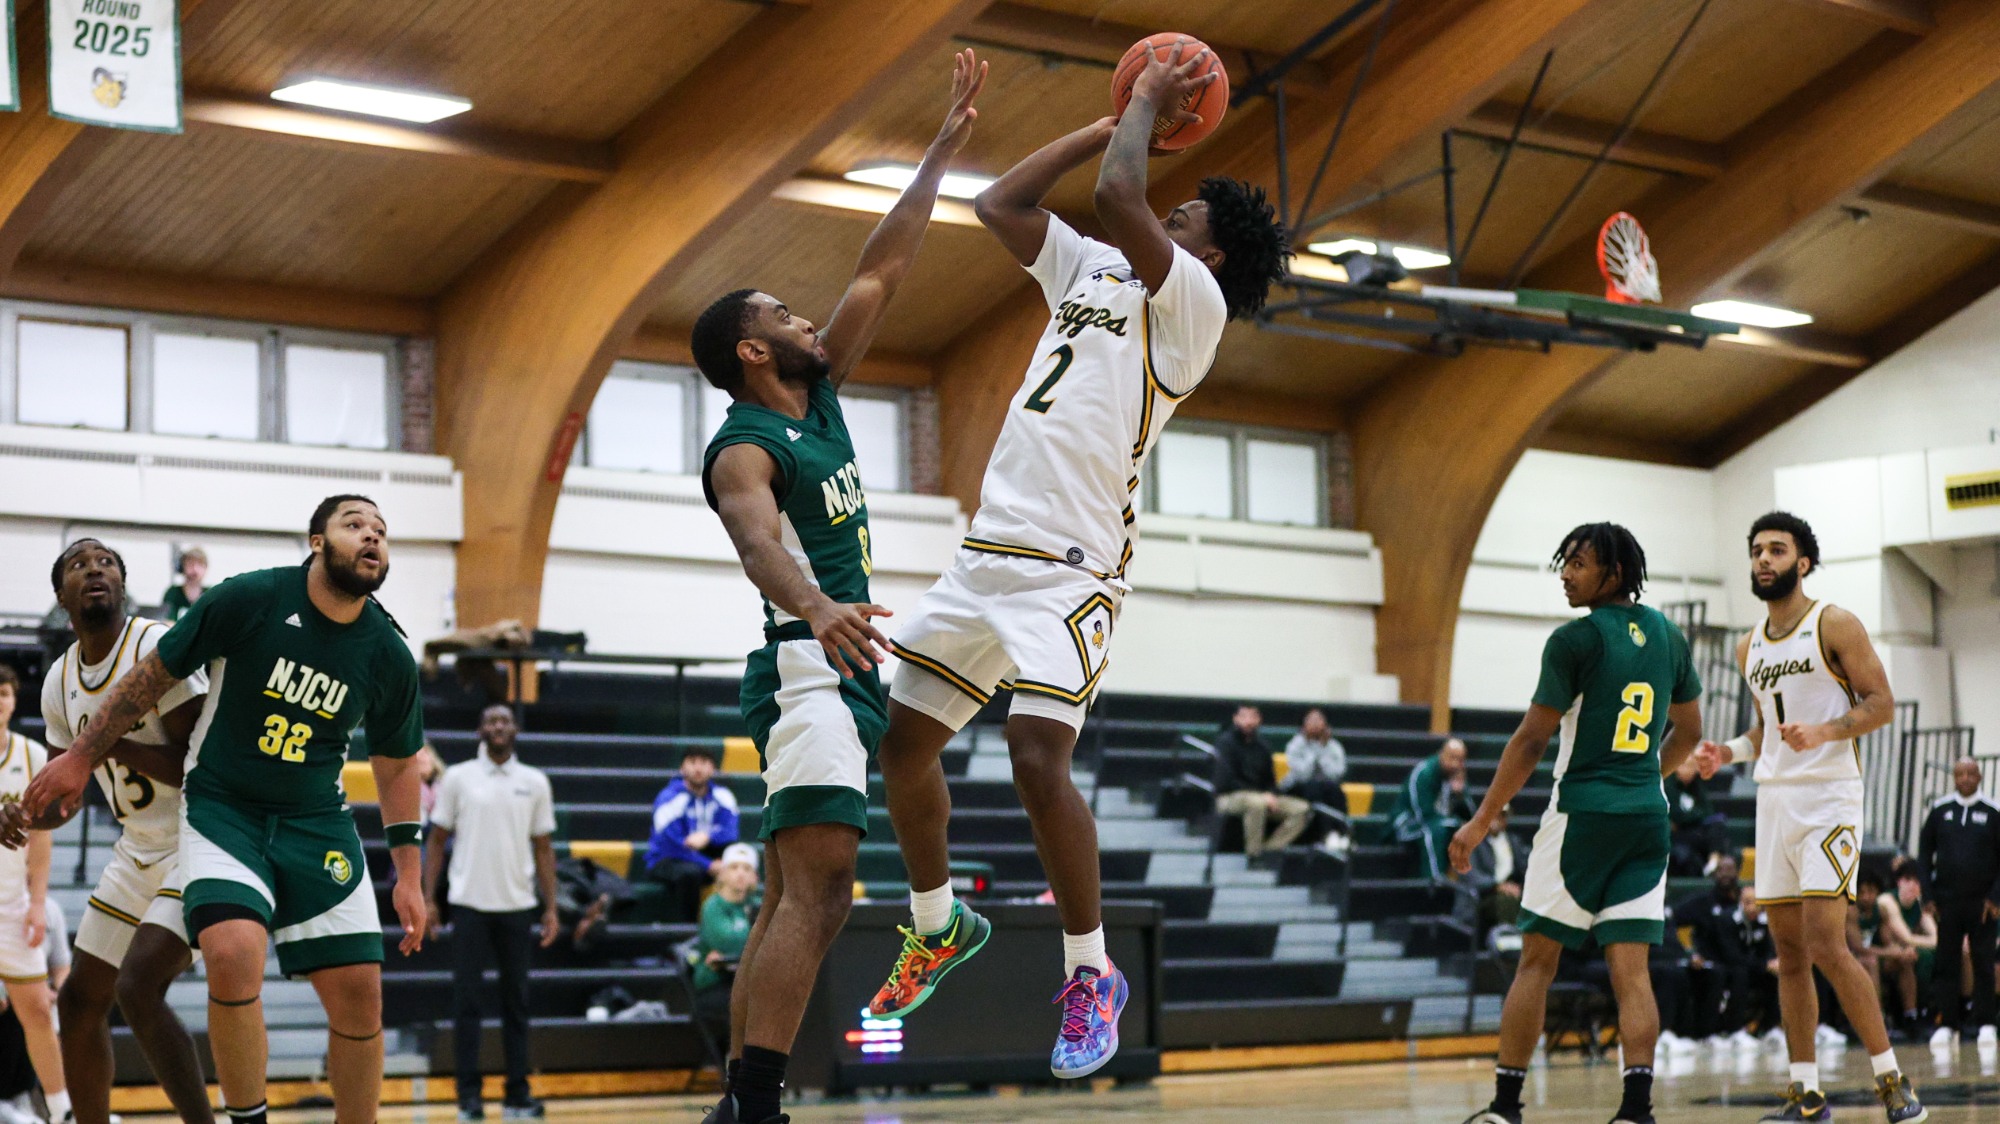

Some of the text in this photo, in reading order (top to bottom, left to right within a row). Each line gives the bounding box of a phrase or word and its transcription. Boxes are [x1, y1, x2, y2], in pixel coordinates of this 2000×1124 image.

[82, 0, 141, 20] ROUND
[73, 19, 152, 57] 2025
[1023, 343, 1073, 415] 2
[265, 656, 349, 714] NJCU
[1749, 658, 1815, 691] Aggies
[258, 713, 313, 763] 32
[1611, 682, 1654, 754] 2
[1773, 692, 1786, 740] 1
